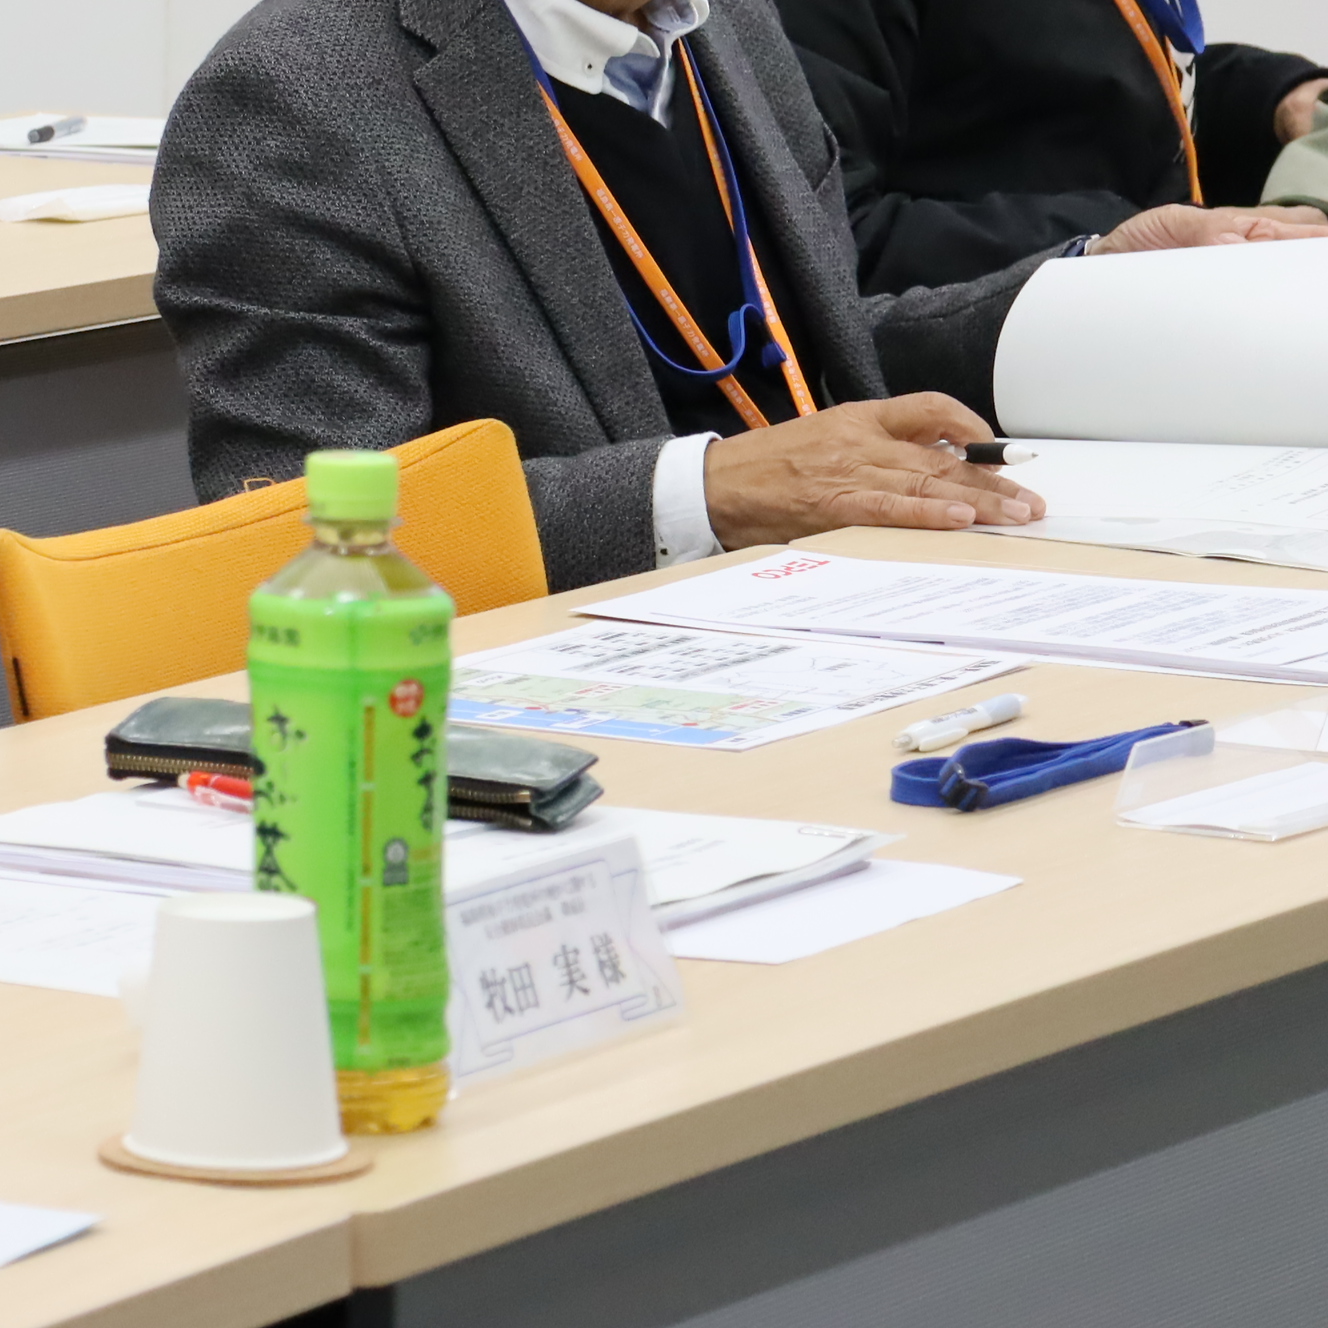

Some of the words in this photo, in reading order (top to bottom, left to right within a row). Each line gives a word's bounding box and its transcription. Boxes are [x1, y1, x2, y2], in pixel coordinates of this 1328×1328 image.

[751, 558, 831, 579] TEPCO
[480, 962, 540, 1023] 牧田
[553, 944, 590, 1002] 実
